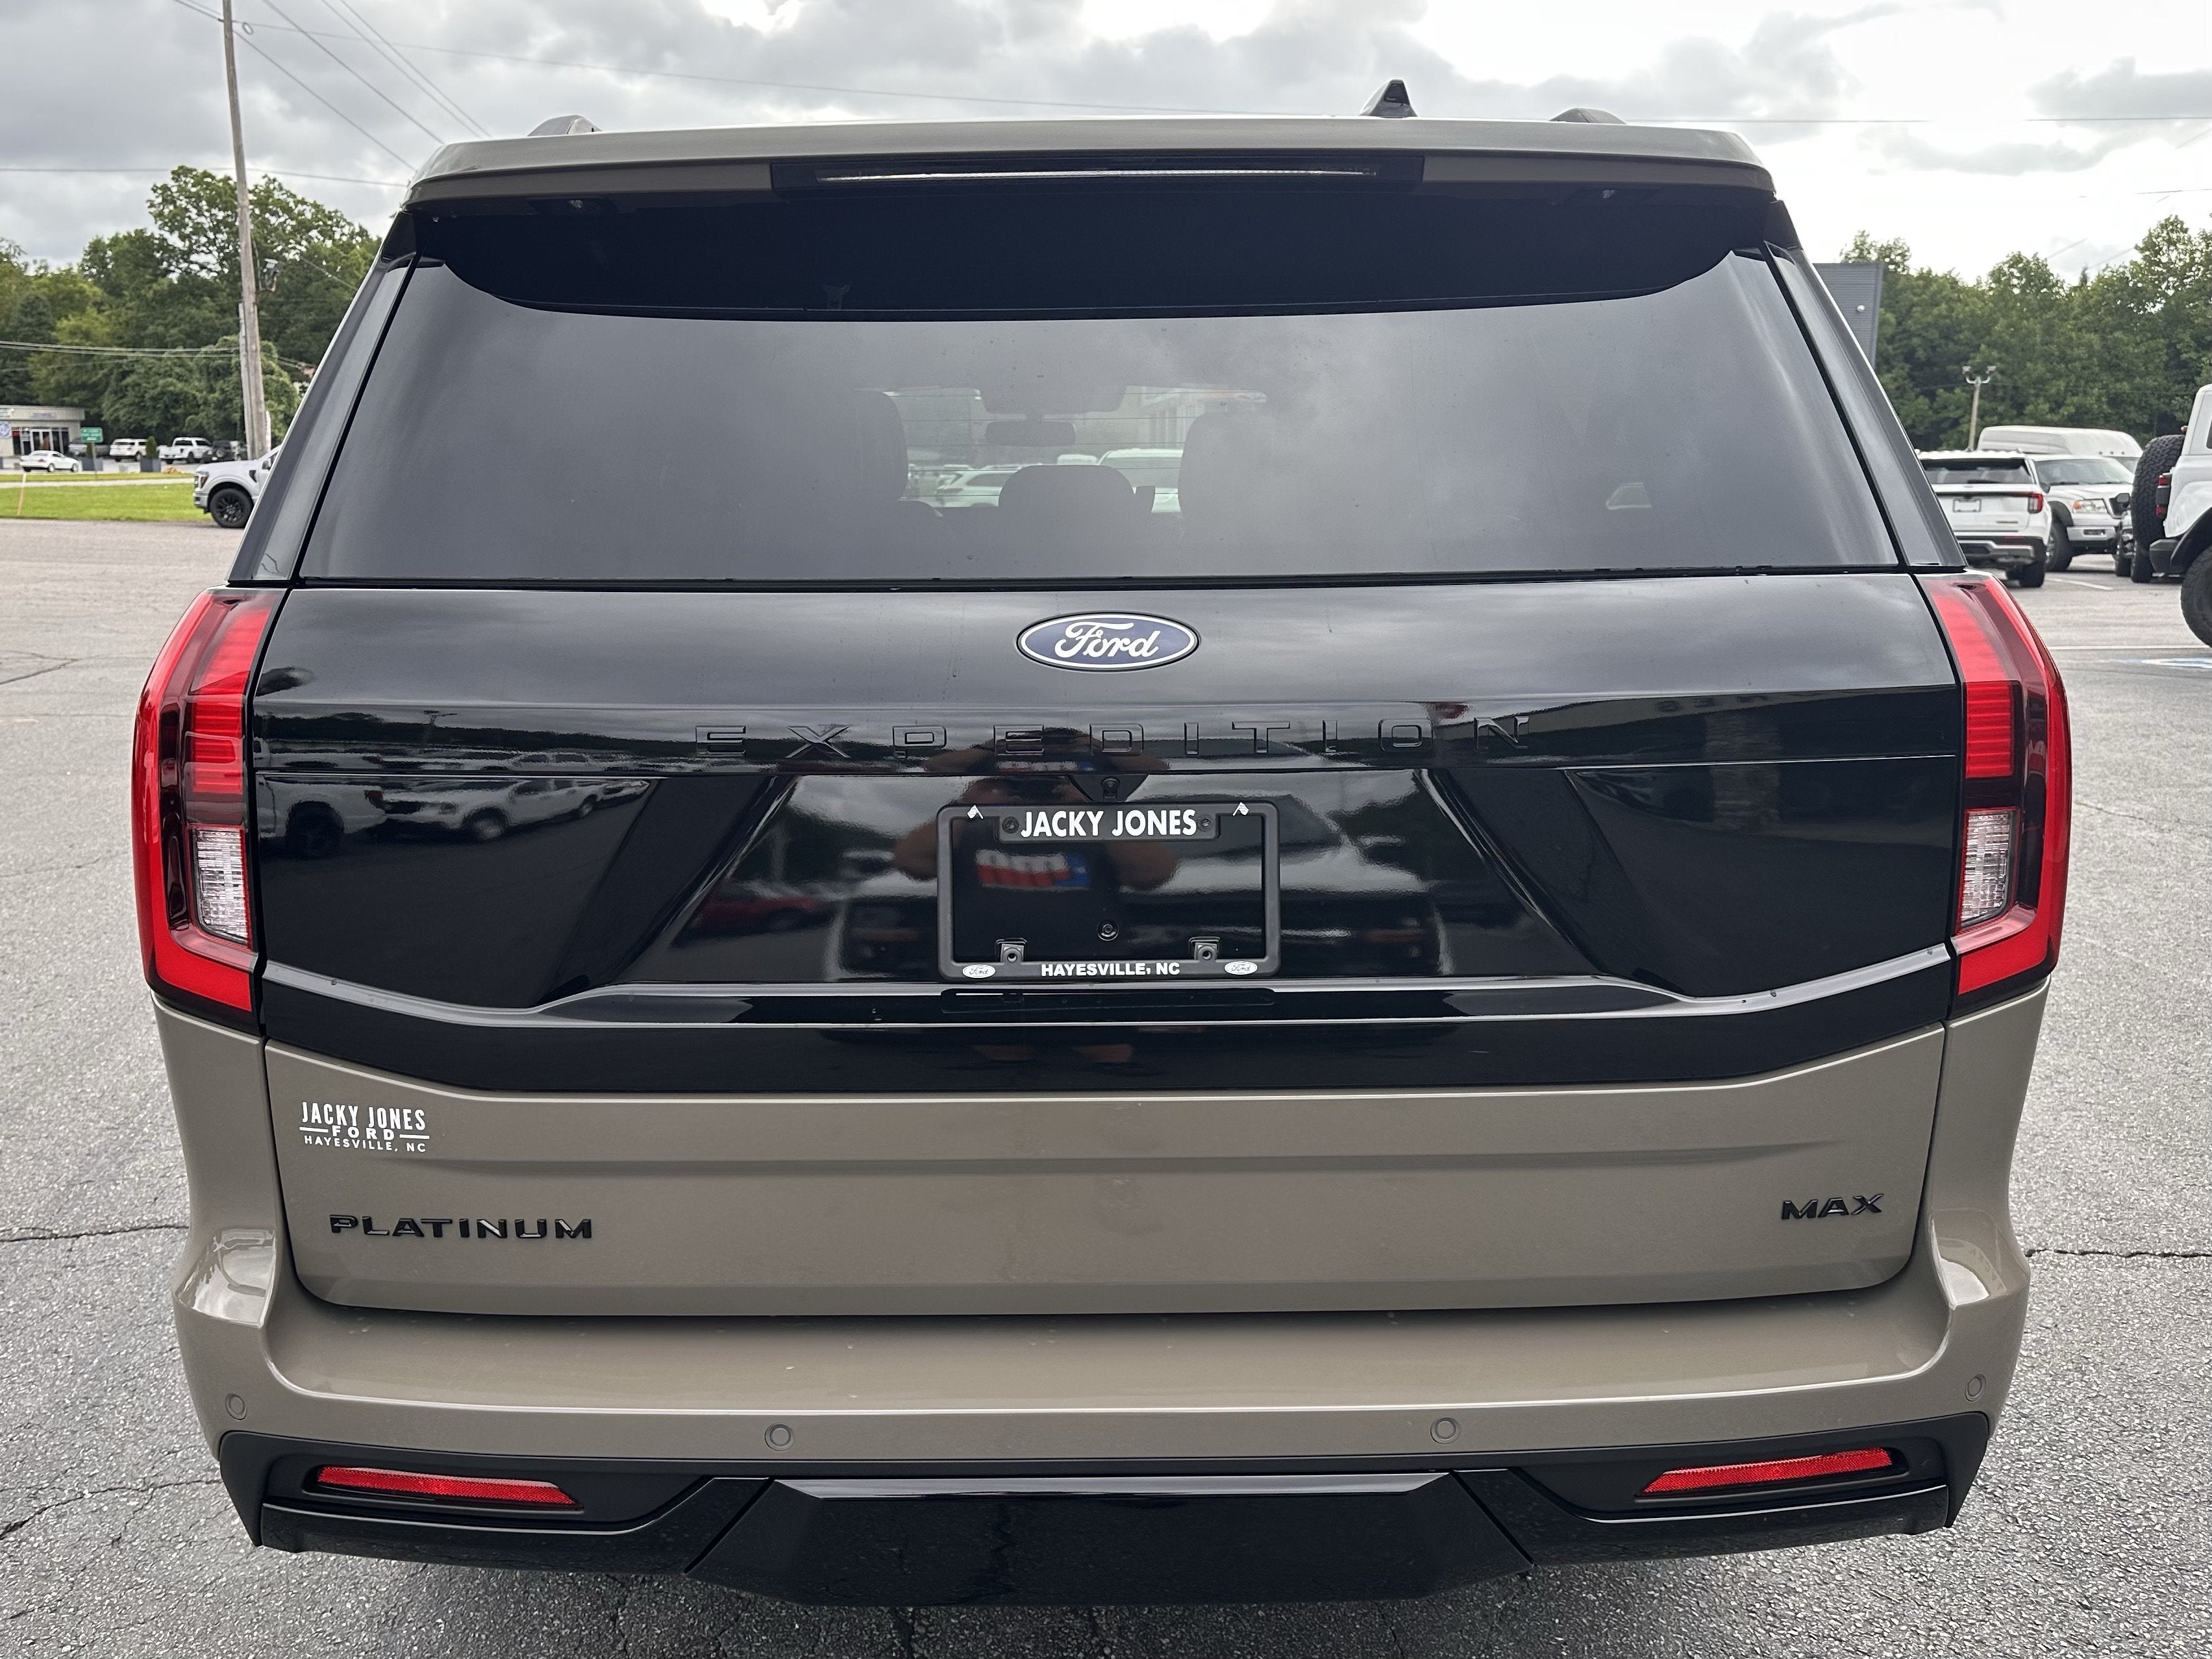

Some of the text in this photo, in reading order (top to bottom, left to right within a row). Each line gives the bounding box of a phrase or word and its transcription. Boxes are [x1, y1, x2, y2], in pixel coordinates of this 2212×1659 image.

[1054, 621, 1161, 658] Ford
[695, 716, 1530, 758] EXPEDITION
[1021, 809, 1197, 838] JACKY JONES
[1041, 962, 1180, 977] HAYESVILLE, NC
[302, 1102, 426, 1130] JACKY JONES
[304, 1135, 426, 1153] HAYESVILLE, NC
[332, 1125, 395, 1141] FORD
[1782, 1193, 1884, 1219] MAX
[329, 1214, 592, 1239] PLATINUM
